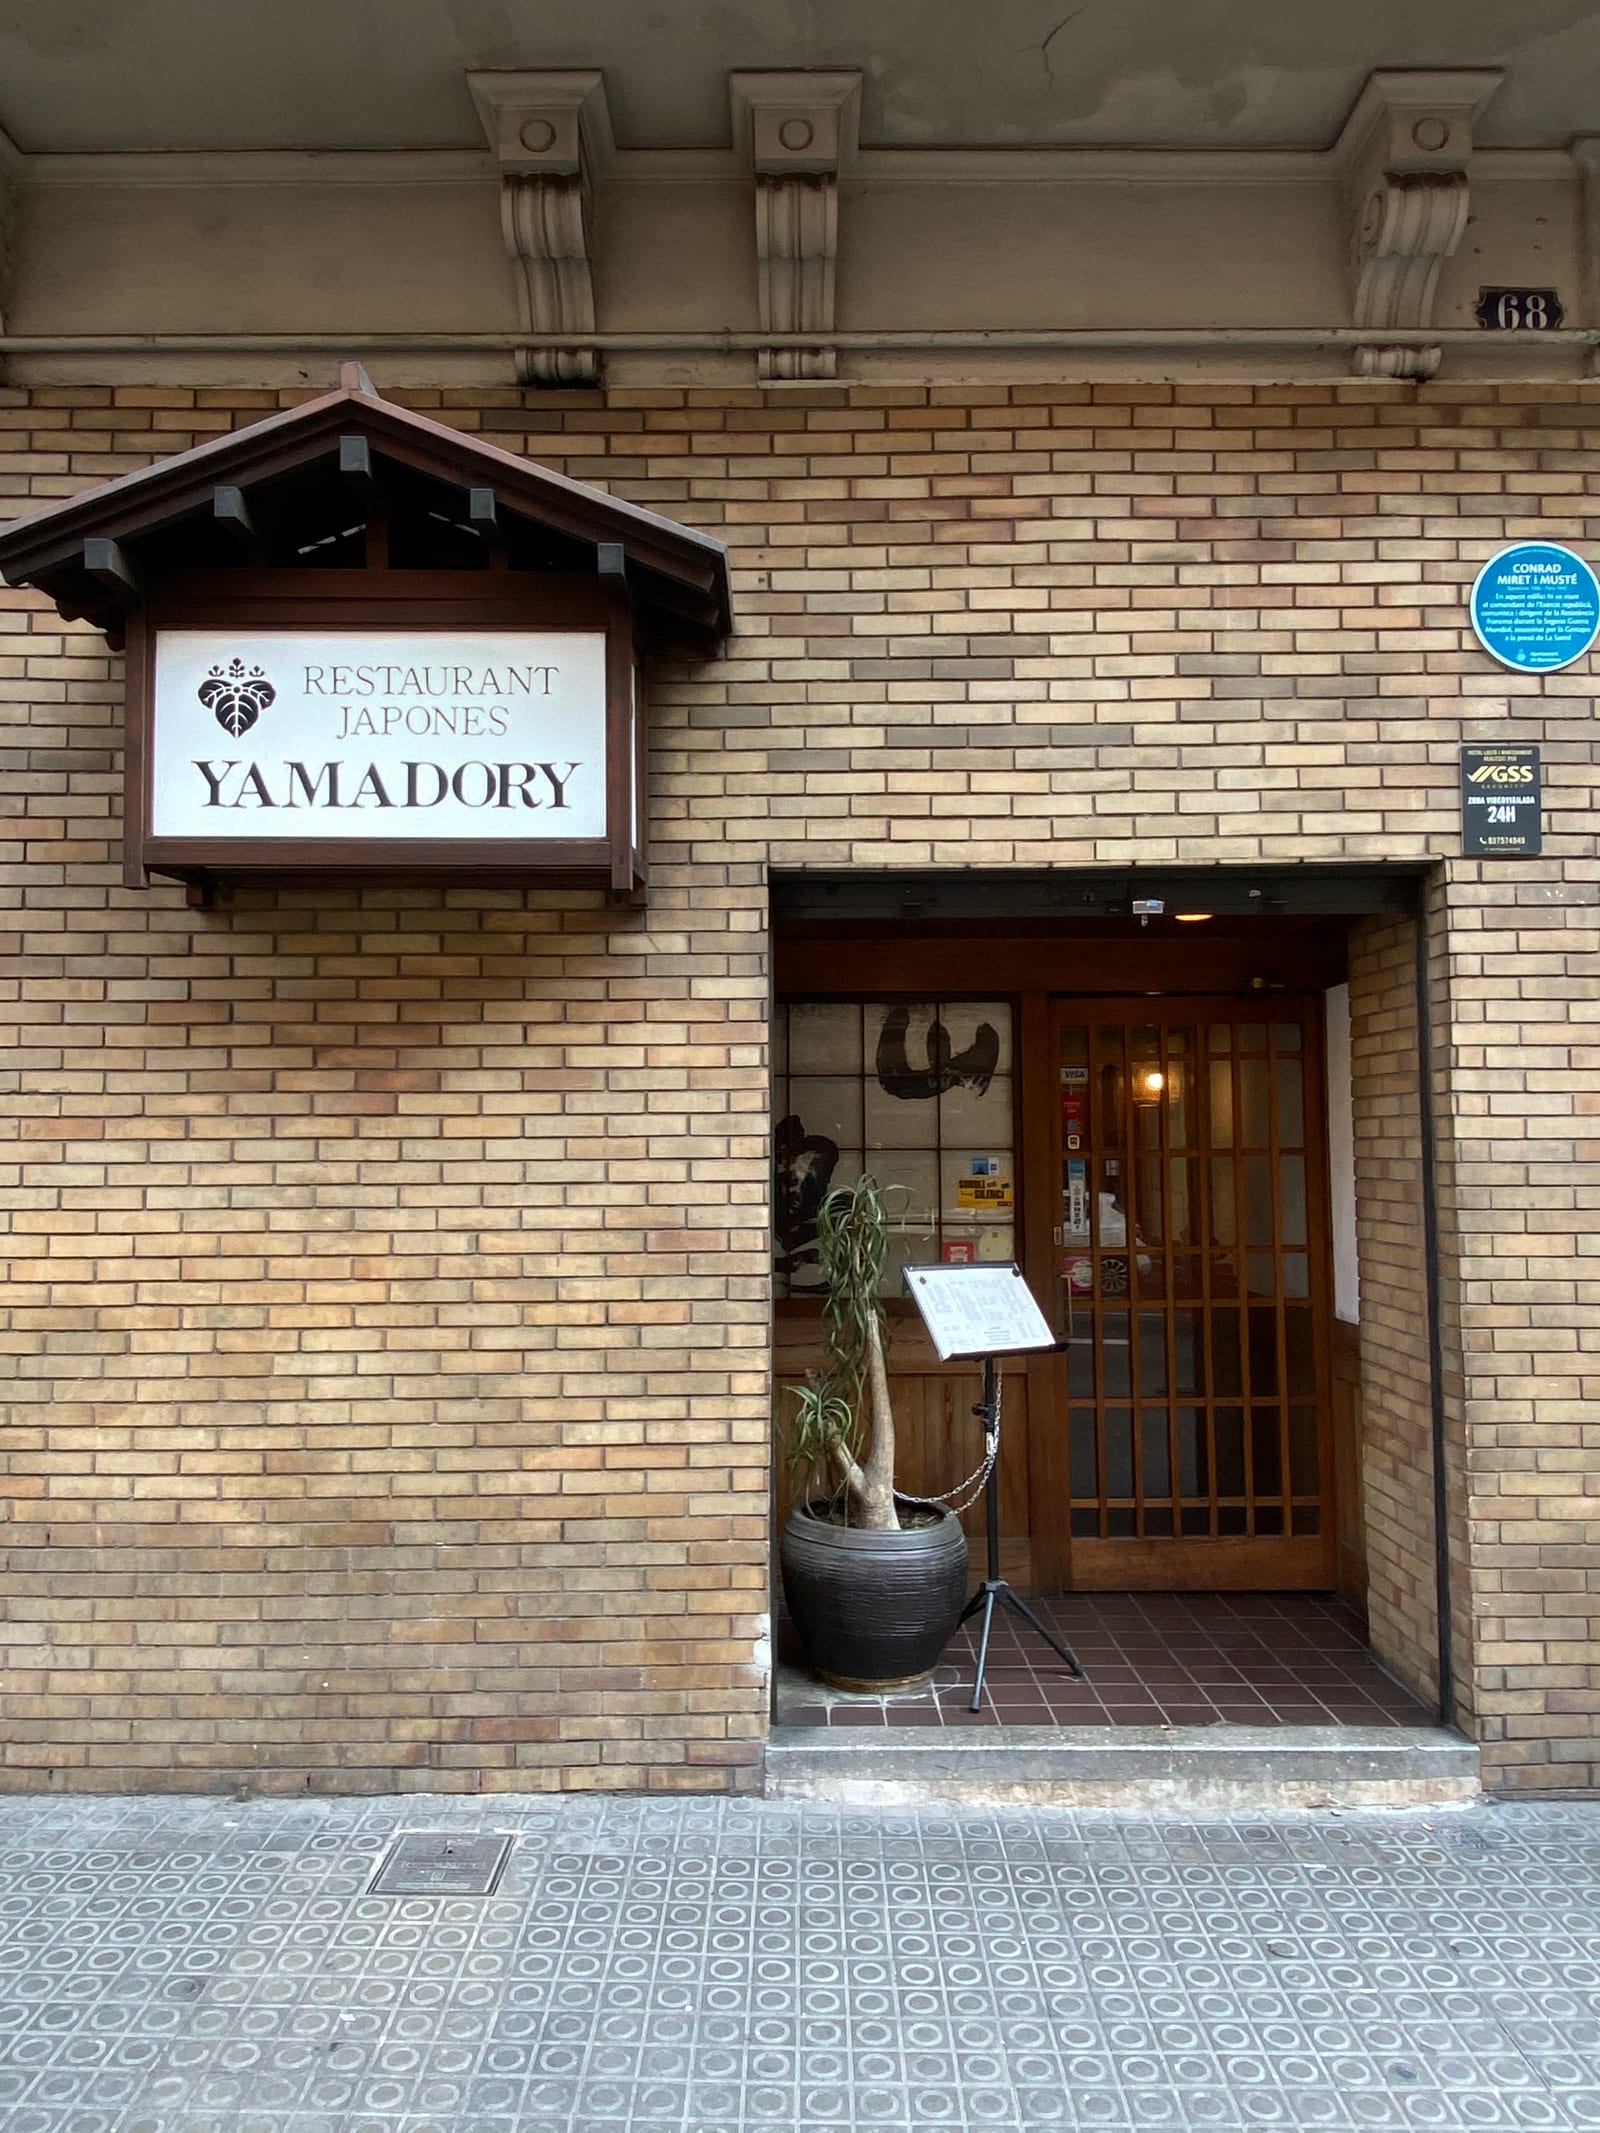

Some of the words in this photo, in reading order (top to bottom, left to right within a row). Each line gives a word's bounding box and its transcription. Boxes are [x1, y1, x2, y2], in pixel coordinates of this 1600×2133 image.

[1497, 293, 1548, 330] 68
[1512, 564, 1561, 573] CONRAD
[1497, 575, 1531, 584] MIRET
[1540, 573, 1578, 584] MUSTÉ
[302, 664, 559, 696] RESTAURANT
[335, 705, 510, 740] JAPONES
[1491, 765, 1534, 783] GSS
[190, 759, 583, 809] YAMADORY
[1487, 805, 1516, 823] 24H
[1064, 1069, 1085, 1079] VISA
